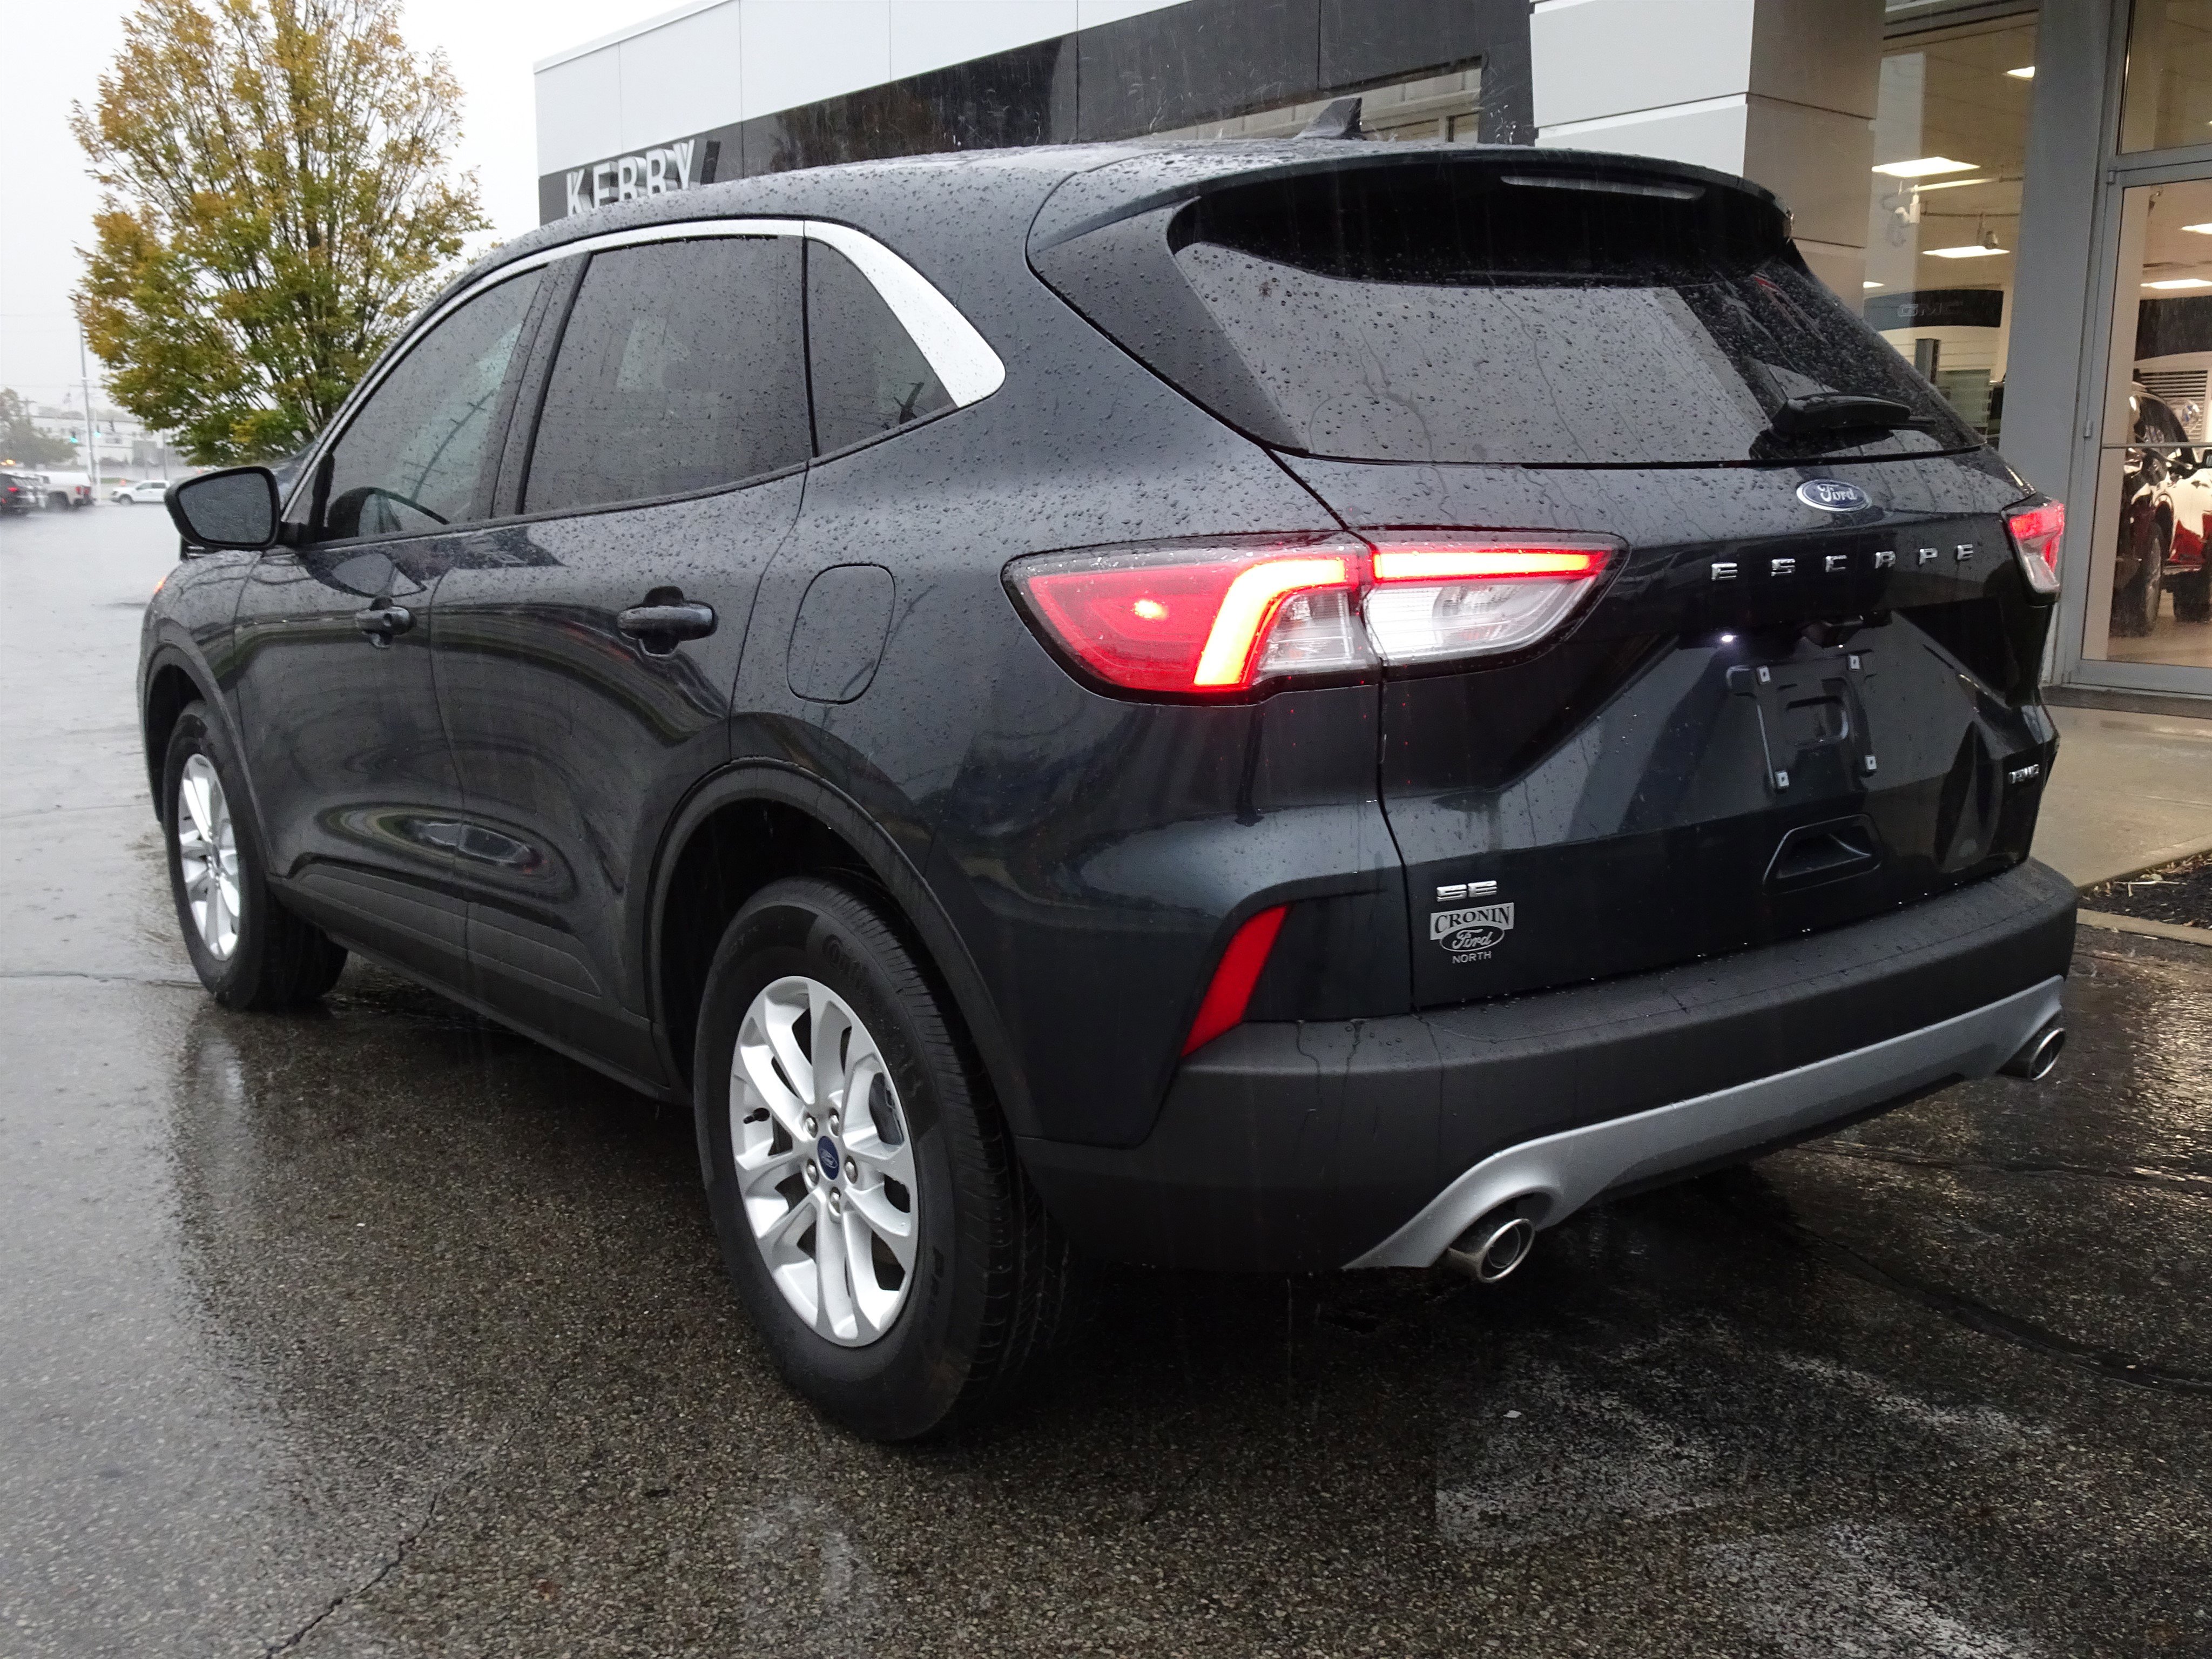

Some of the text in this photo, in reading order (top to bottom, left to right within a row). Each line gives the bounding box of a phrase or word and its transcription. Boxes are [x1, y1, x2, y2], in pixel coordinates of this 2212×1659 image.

[1817, 484, 1857, 502] Ford
[1711, 543, 1974, 581] ESCAPE
[1437, 880, 1498, 902] SE
[1434, 906, 1510, 934] CRONIN
[1451, 928, 1493, 949] Ford
[1452, 950, 1492, 964] NORTH
